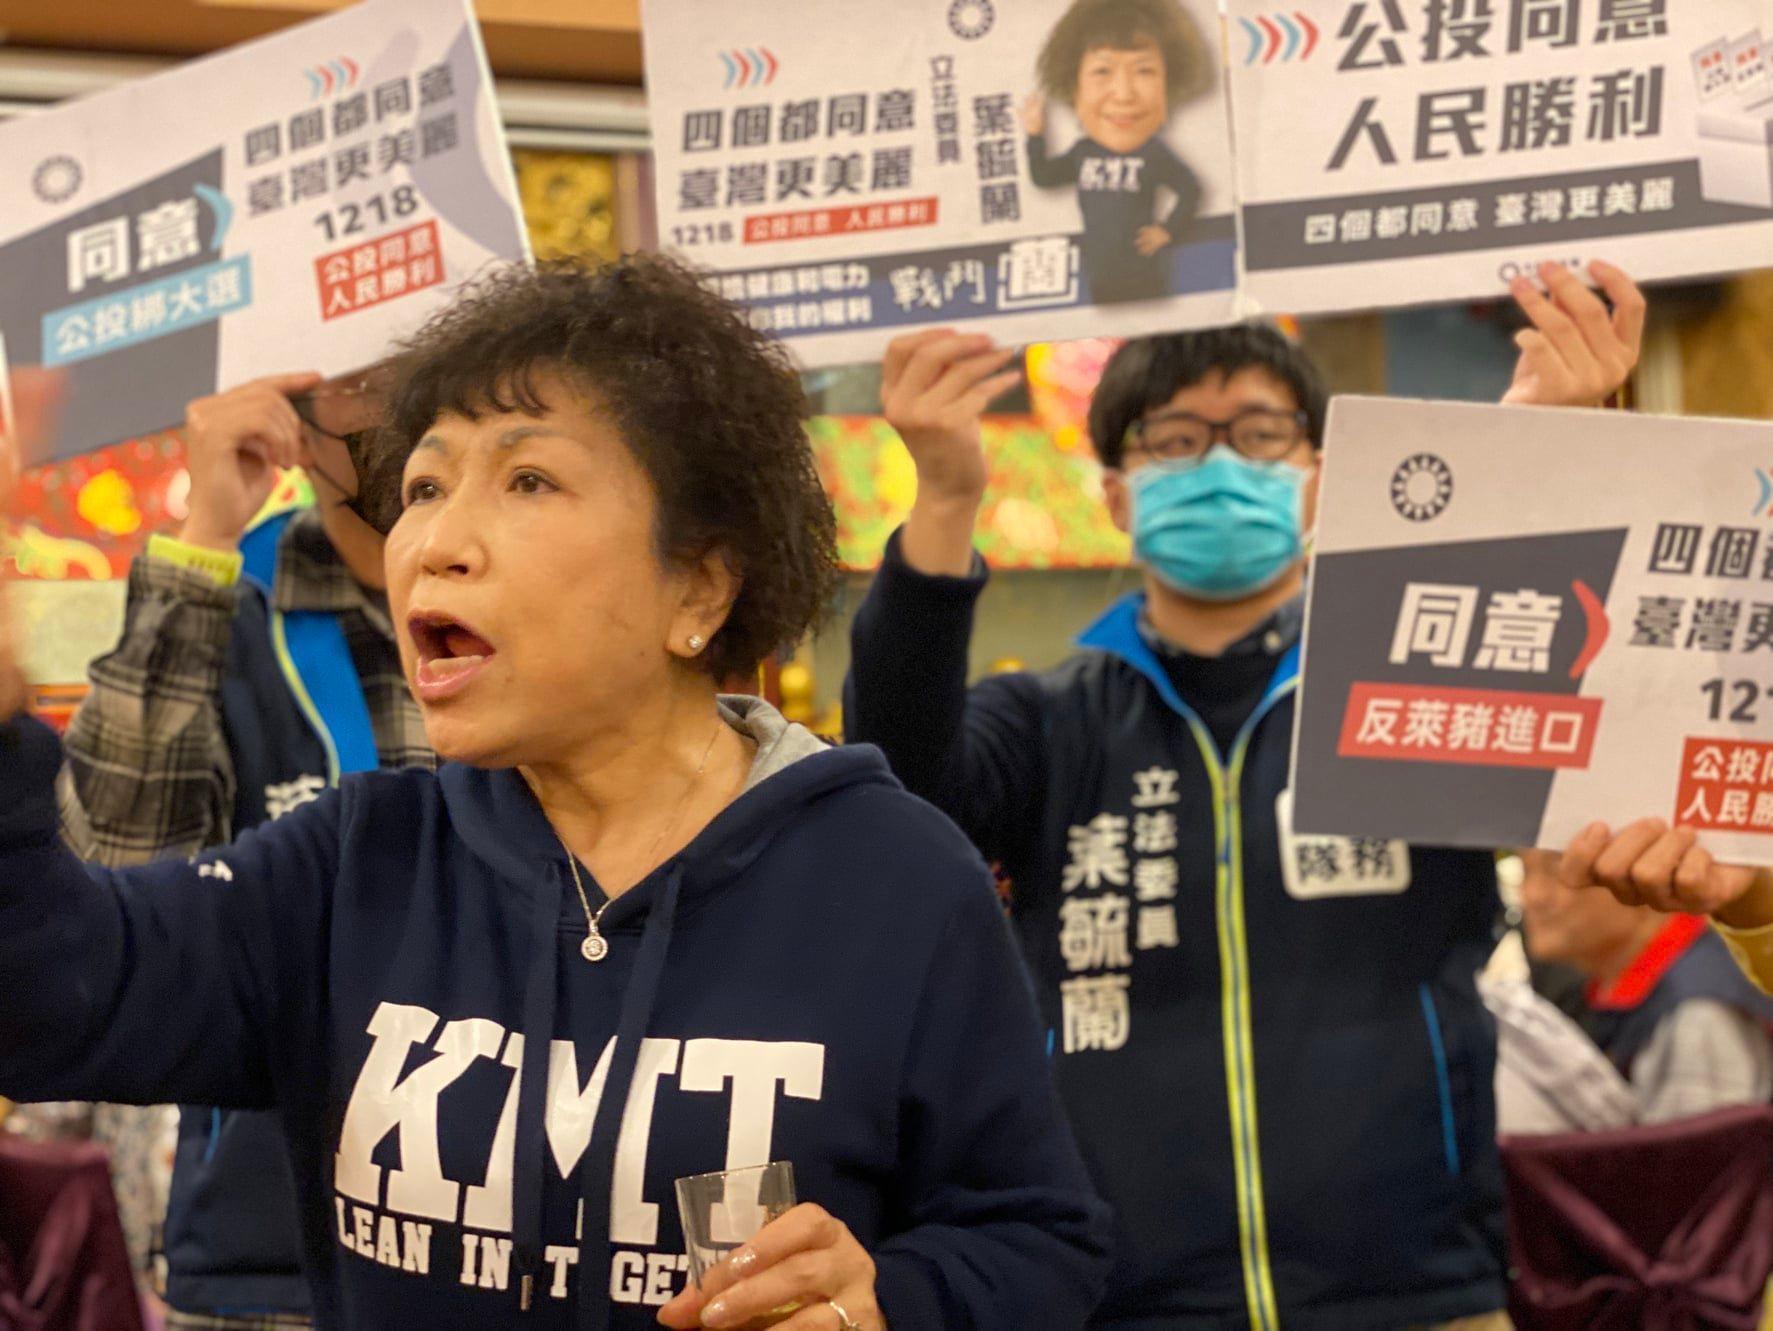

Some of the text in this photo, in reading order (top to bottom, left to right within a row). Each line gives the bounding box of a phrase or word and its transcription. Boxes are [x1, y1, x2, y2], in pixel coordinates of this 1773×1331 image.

[1336, 0, 1671, 72] 公投同意
[245, 63, 455, 167] 四個都同意
[682, 88, 916, 153] 四個都同意
[930, 54, 961, 165] 立法委員
[1324, 66, 1665, 172] 人民勝利
[248, 112, 458, 218] 臺灣更美麗
[678, 146, 912, 212] 臺灣更美麗
[67, 198, 201, 293] 同意
[313, 184, 419, 241] 1218
[672, 222, 733, 246] 1218
[1303, 176, 1676, 245] 四個都同意 臺灣更美麗
[323, 227, 434, 286] 公投同意
[325, 256, 438, 316] 人民勝利
[55, 266, 243, 355] 公投綁大選
[1648, 522, 1773, 582] 四個
[1388, 581, 1563, 673] 同意
[1356, 698, 1585, 755] 反萊豬進口
[1701, 677, 1773, 723] 12
[1130, 765, 1181, 950] 立法委員
[1058, 812, 1133, 1054] 葉毓蘭
[335, 1001, 825, 1244] KMT
[335, 1196, 432, 1274] LEAN
[460, 1233, 513, 1290] IN
